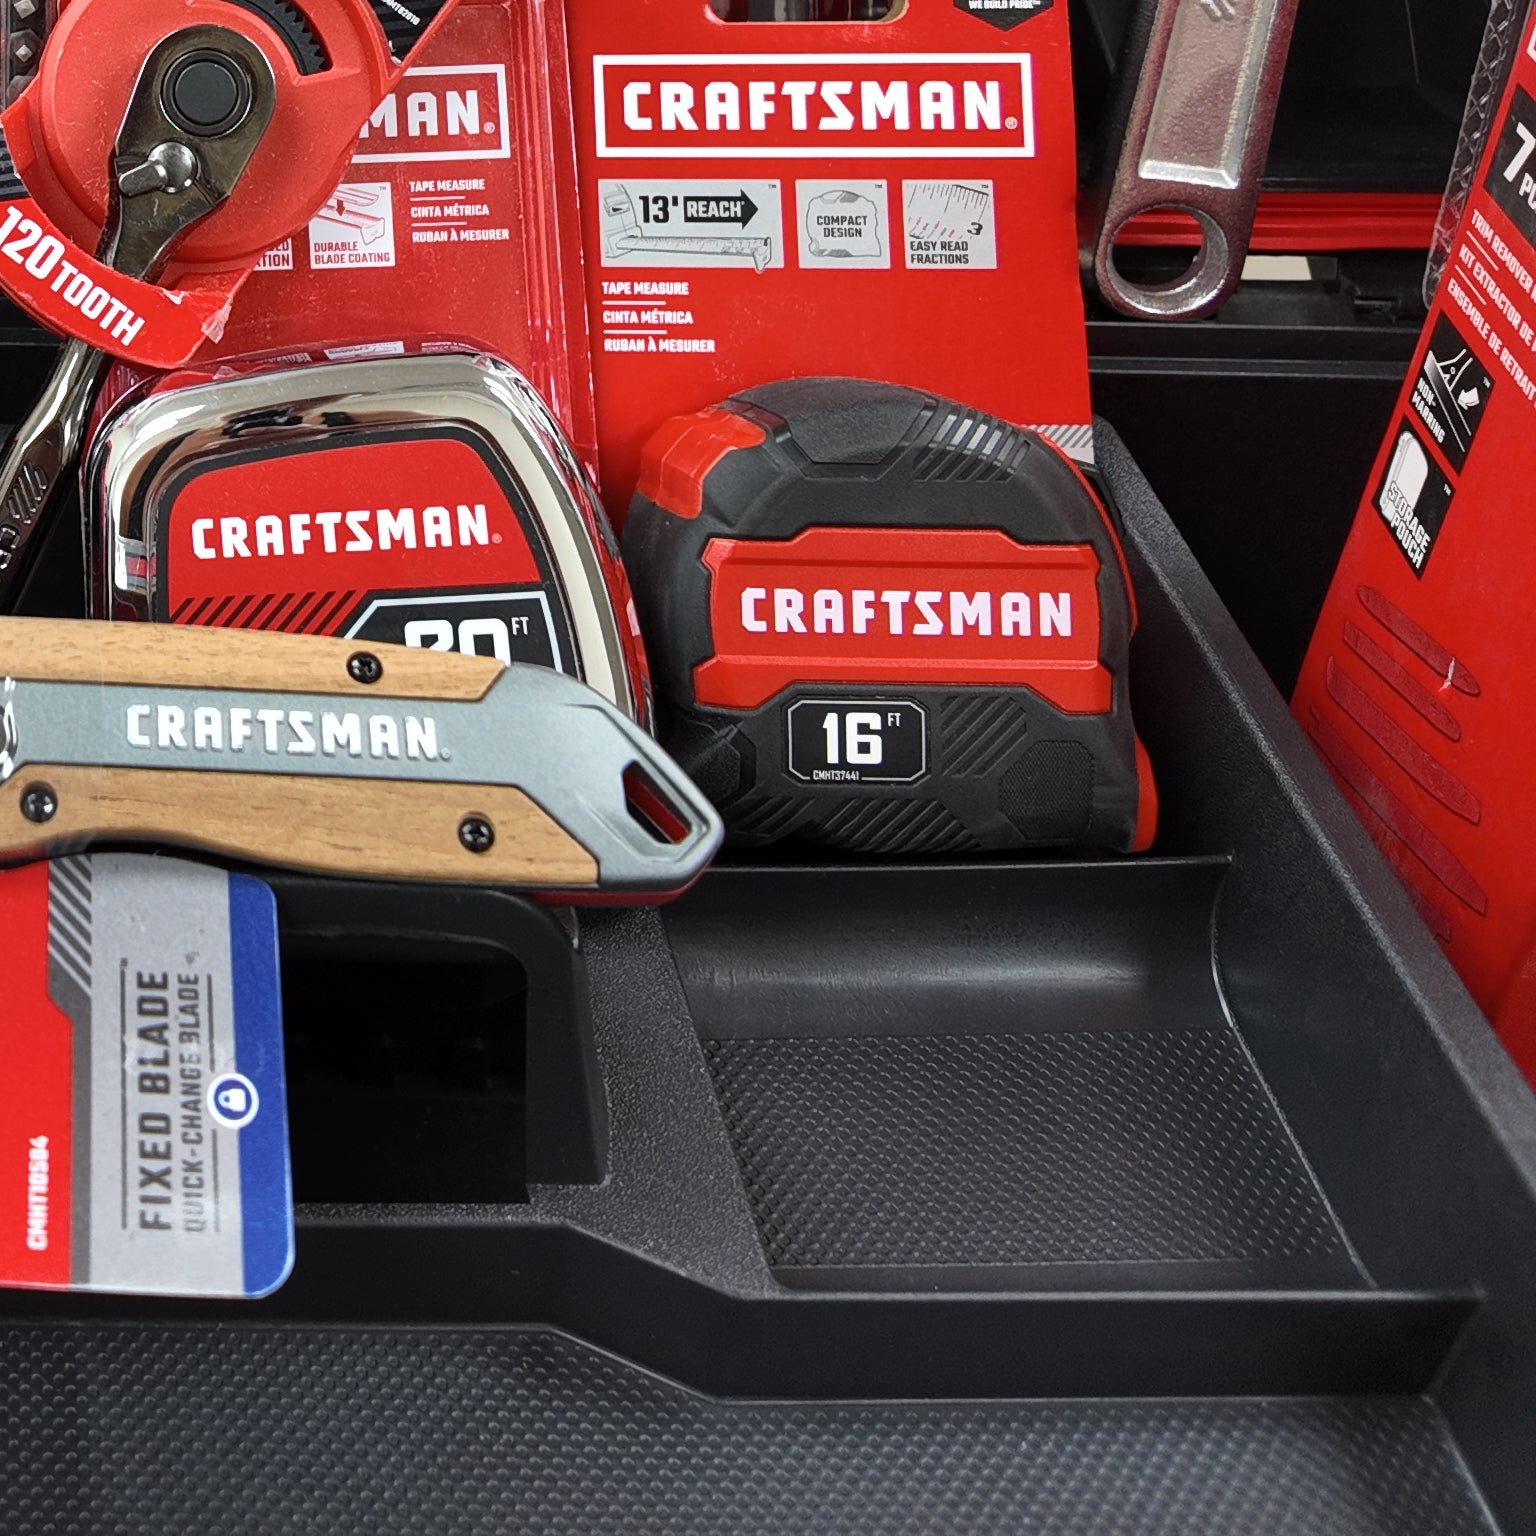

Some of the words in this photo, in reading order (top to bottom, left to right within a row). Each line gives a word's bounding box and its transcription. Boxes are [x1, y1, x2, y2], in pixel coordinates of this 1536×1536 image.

[639, 196, 678, 223] 13'
[817, 215, 868, 227] COMPACT
[823, 227, 862, 238] DESIGN
[314, 242, 358, 252] DURABLE
[314, 254, 345, 264] BLADE
[349, 252, 390, 262] COATING
[910, 241, 937, 252] EASY
[940, 241, 968, 252] READ
[910, 253, 969, 265] FRACTIONS
[1471, 208, 1492, 240] TRIM
[1492, 237, 1530, 293] REMOVER
[50, 258, 145, 346] TOOTH
[602, 282, 631, 296] TAPE
[633, 282, 689, 296] MEASURE
[1460, 244, 1474, 268] KIT
[1472, 261, 1520, 330] EXTRACTOR
[1518, 320, 1532, 346] DE
[603, 311, 636, 325] CINTA
[639, 308, 693, 324] MÉTRICA
[1447, 278, 1488, 340] ENSEMBLE
[1487, 331, 1502, 356] DE
[1500, 350, 1535, 400] RETRAIT
[604, 338, 644, 353] RUBAN
[648, 335, 656, 352] À
[659, 339, 716, 353] MESURER
[1389, 481, 1430, 553] STORAGE
[1391, 512, 1424, 569] POUCH
[741, 587, 1072, 637] CRAFTSMAN
[126, 703, 438, 760] CRAFTSMAN
[822, 712, 883, 765] 16
[888, 713, 901, 727] FT
[136, 971, 171, 1096] BLADE
[176, 973, 201, 1044] BLADE
[179, 1052, 205, 1233] QUICK-CHANGE
[138, 1112, 173, 1231] FIXED
